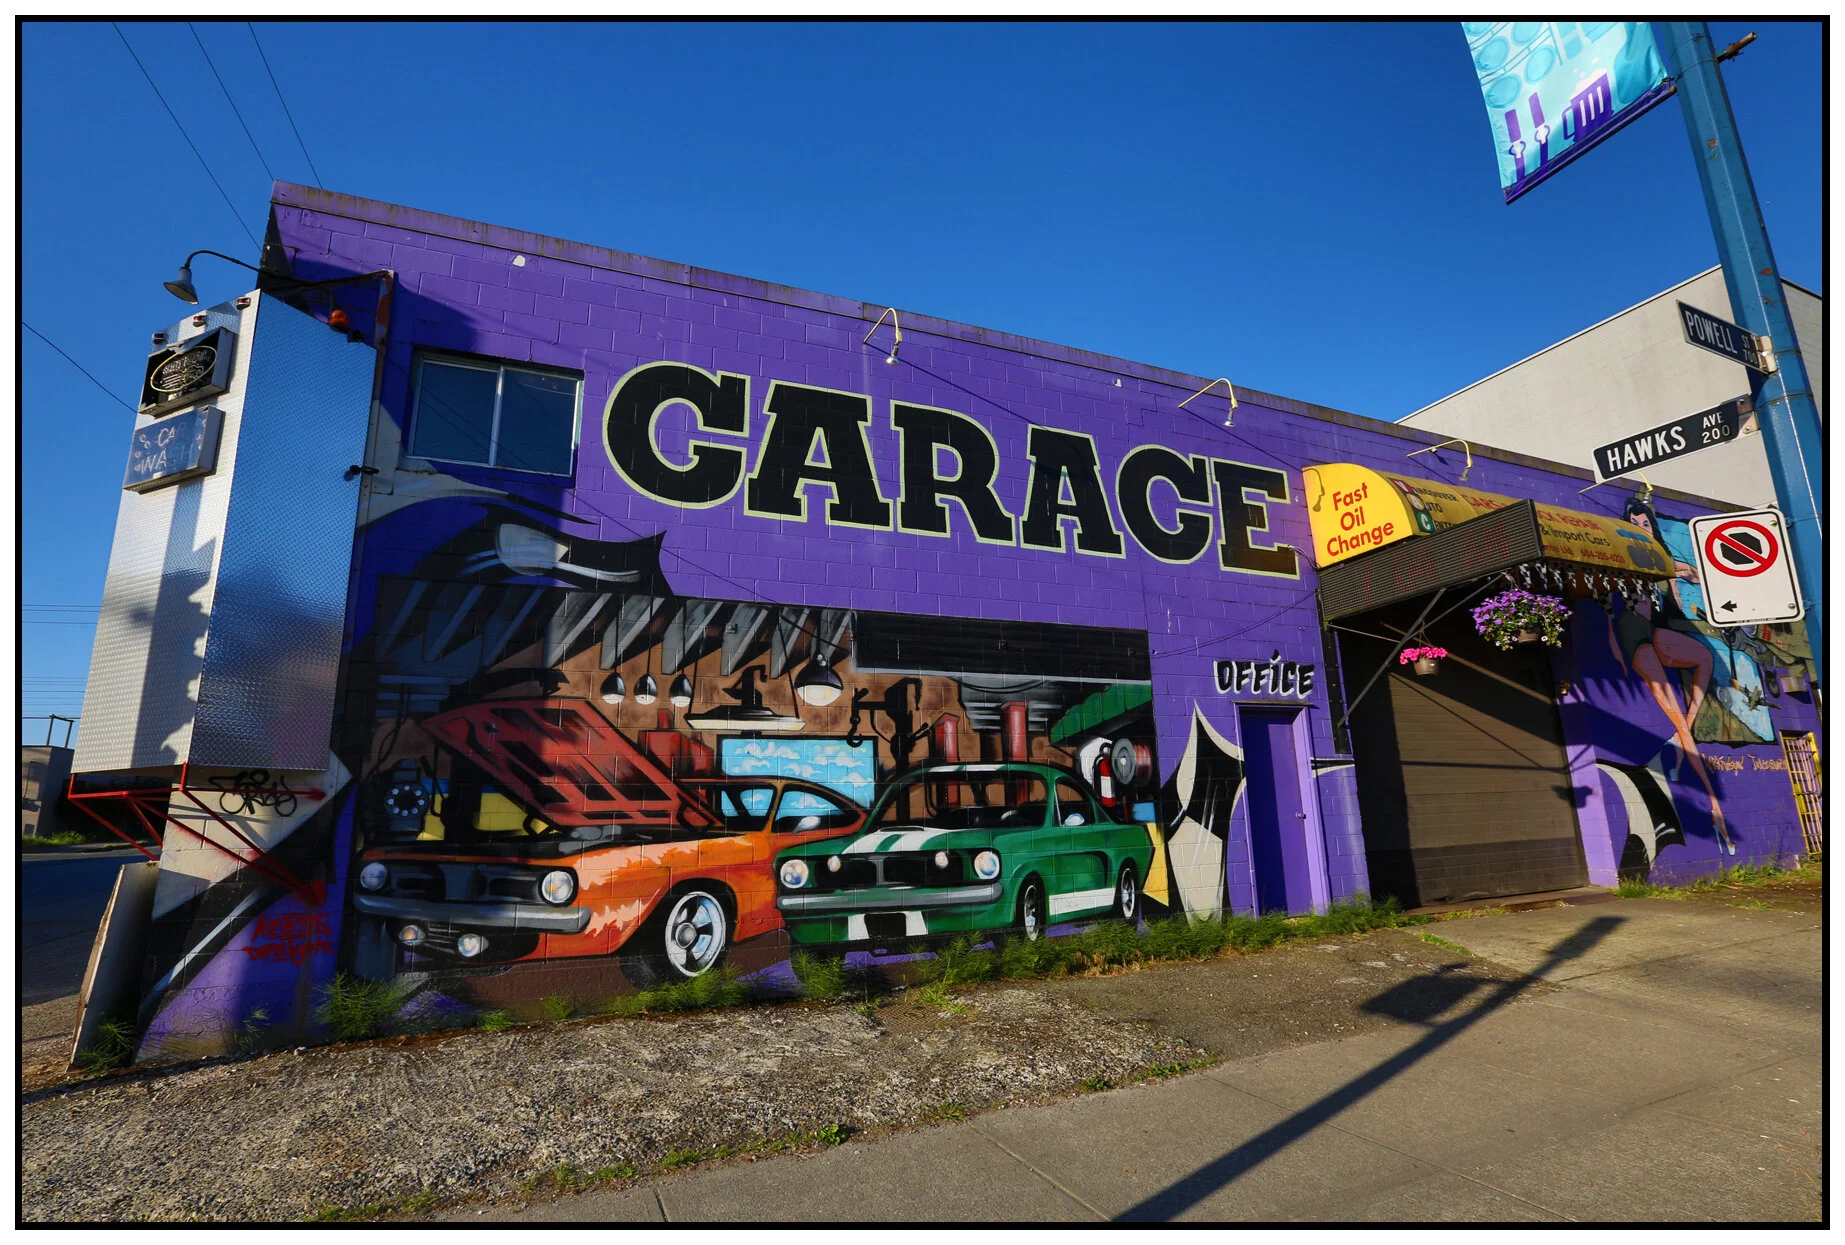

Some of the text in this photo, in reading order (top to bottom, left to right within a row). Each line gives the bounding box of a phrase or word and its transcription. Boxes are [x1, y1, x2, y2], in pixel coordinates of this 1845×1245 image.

[1684, 310, 1738, 354] POWELL
[1606, 411, 1725, 472] HAWKS AVE
[1701, 424, 1731, 444] 200
[603, 361, 1300, 579] GARAGE
[1332, 482, 1368, 511] Fast
[1340, 506, 1365, 531] Oil
[1327, 522, 1394, 557] Change
[1549, 525, 1585, 543] Import
[1585, 532, 1611, 547] Cars
